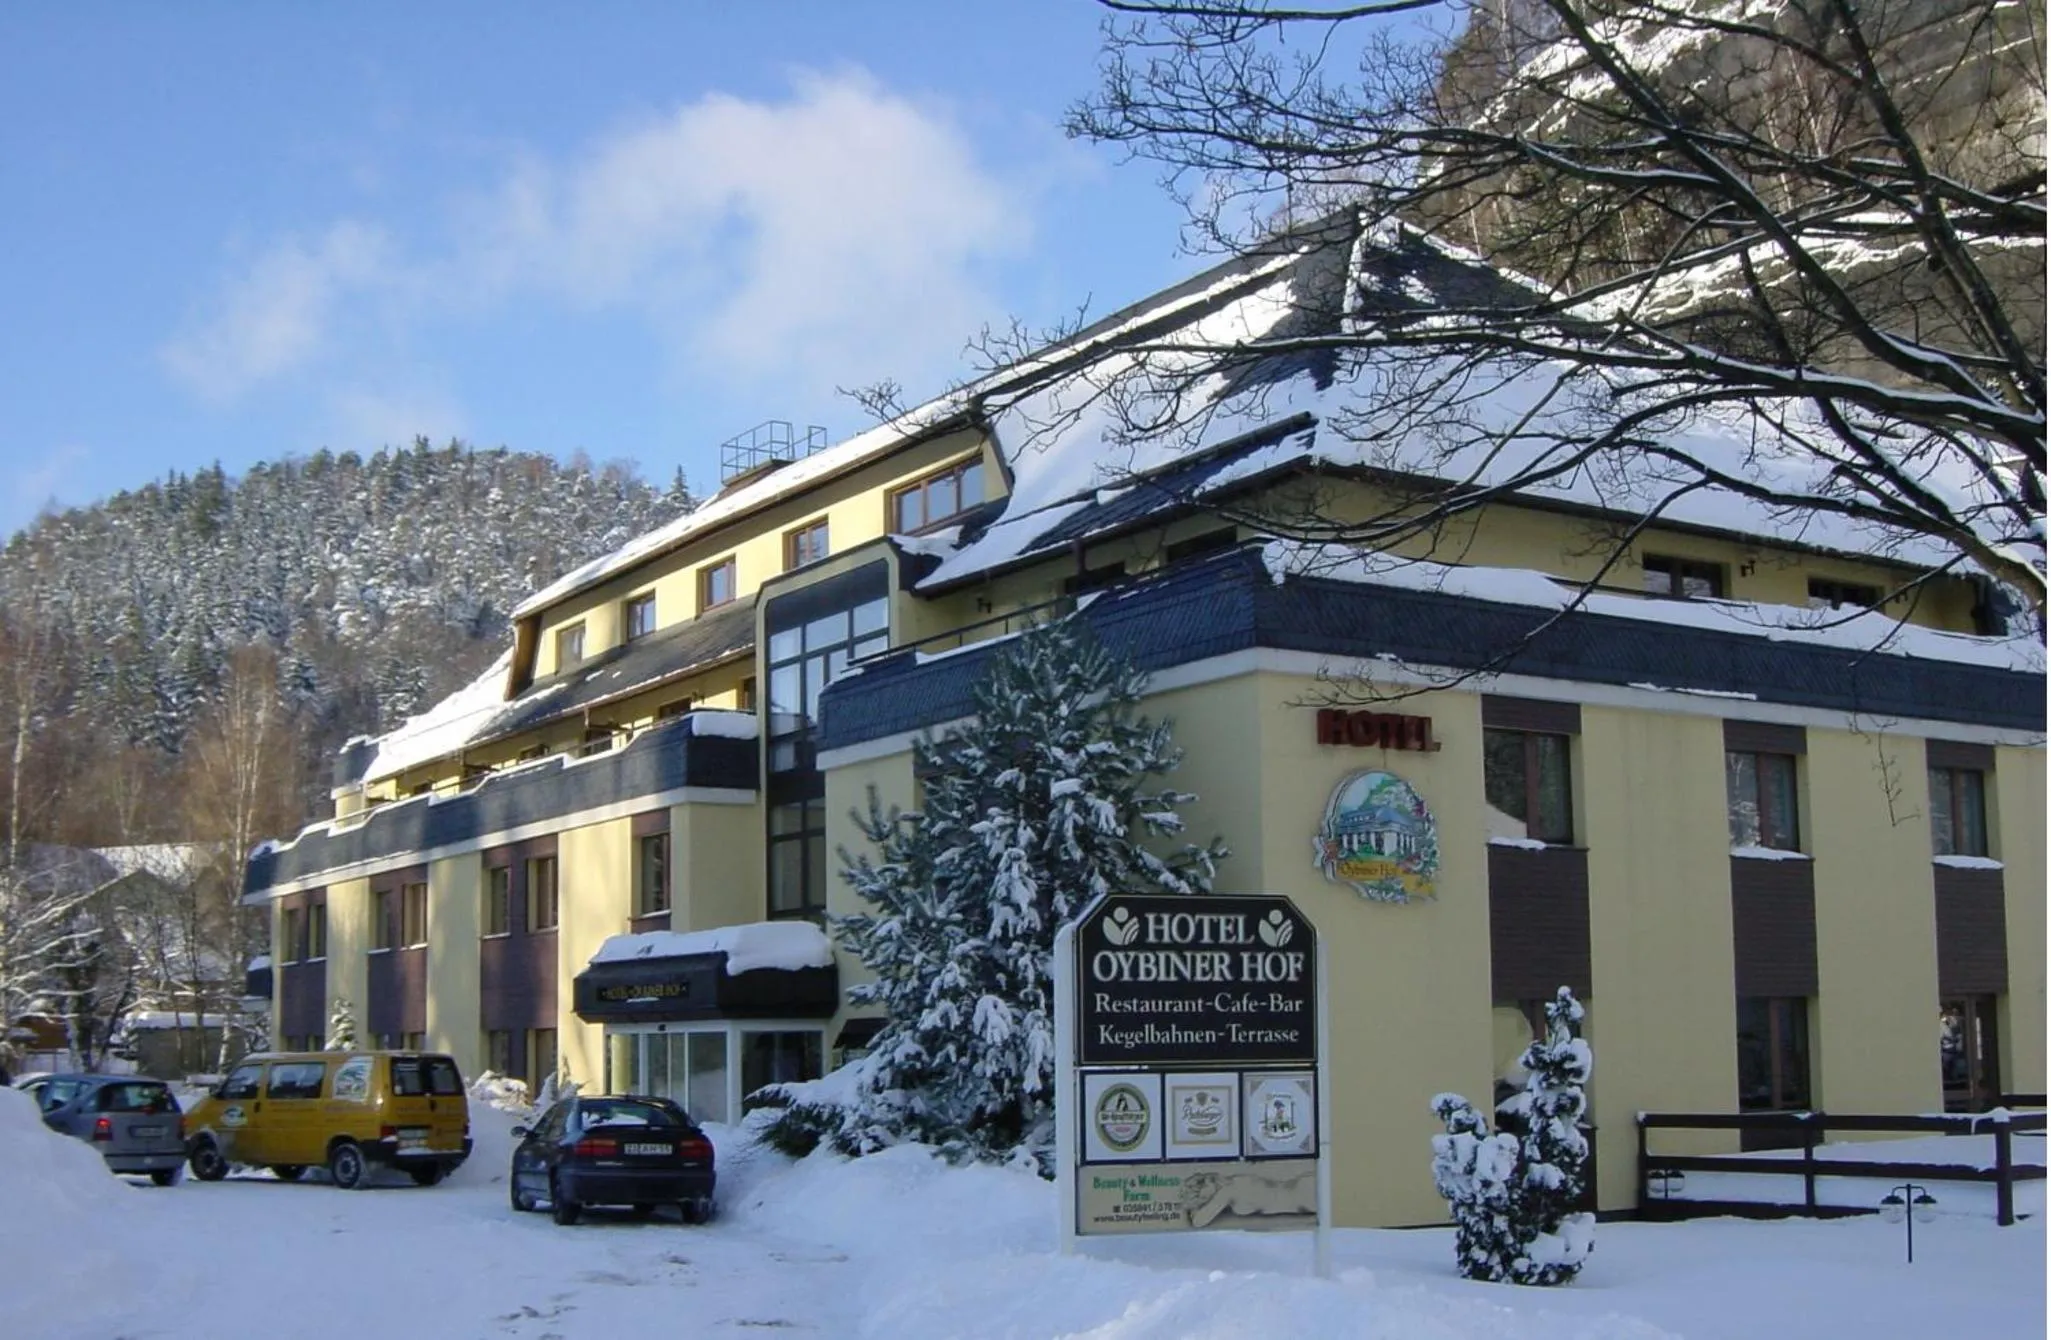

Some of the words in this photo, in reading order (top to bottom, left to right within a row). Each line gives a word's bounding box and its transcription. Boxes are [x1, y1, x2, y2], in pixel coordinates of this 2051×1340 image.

[1317, 709, 1441, 752] HOTEL
[1144, 912, 1255, 945] HOTEL
[1092, 950, 1234, 982] OYBINER
[1240, 951, 1305, 982] HOF
[1094, 992, 1304, 1014] Restaurant-Cafe-Bar
[1098, 1023, 1299, 1049] Kegelbahnen-Terrasse
[1093, 1176, 1127, 1191] Beauty
[1138, 1174, 1180, 1188] Wellness
[1123, 1190, 1150, 1202] Farm
